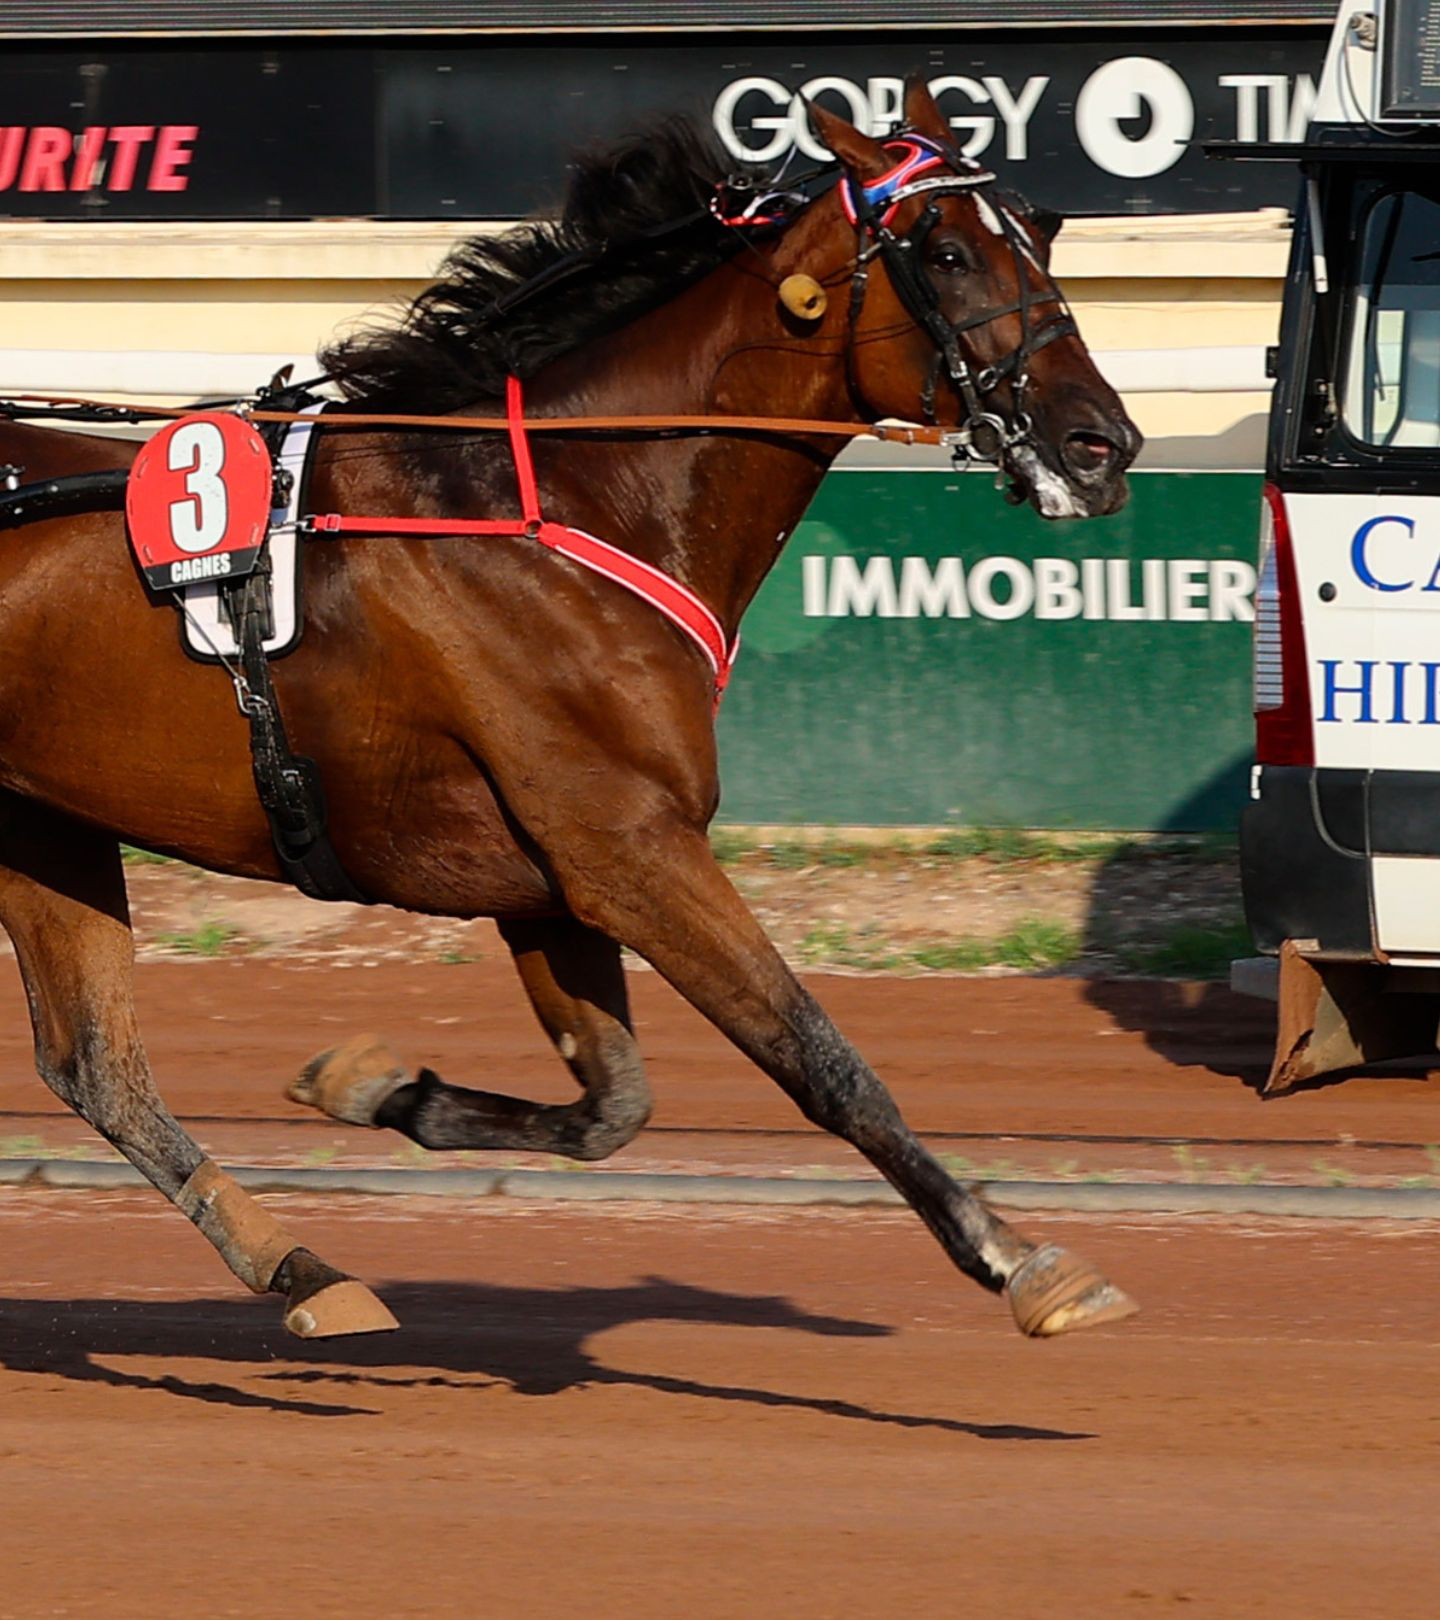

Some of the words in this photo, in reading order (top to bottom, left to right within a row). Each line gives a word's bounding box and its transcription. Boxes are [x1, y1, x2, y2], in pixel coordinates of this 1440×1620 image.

[169, 422, 228, 553] 3
[171, 552, 231, 583] CAGNES
[802, 555, 1257, 622] IMMOBILIER
[1350, 515, 1440, 592] C
